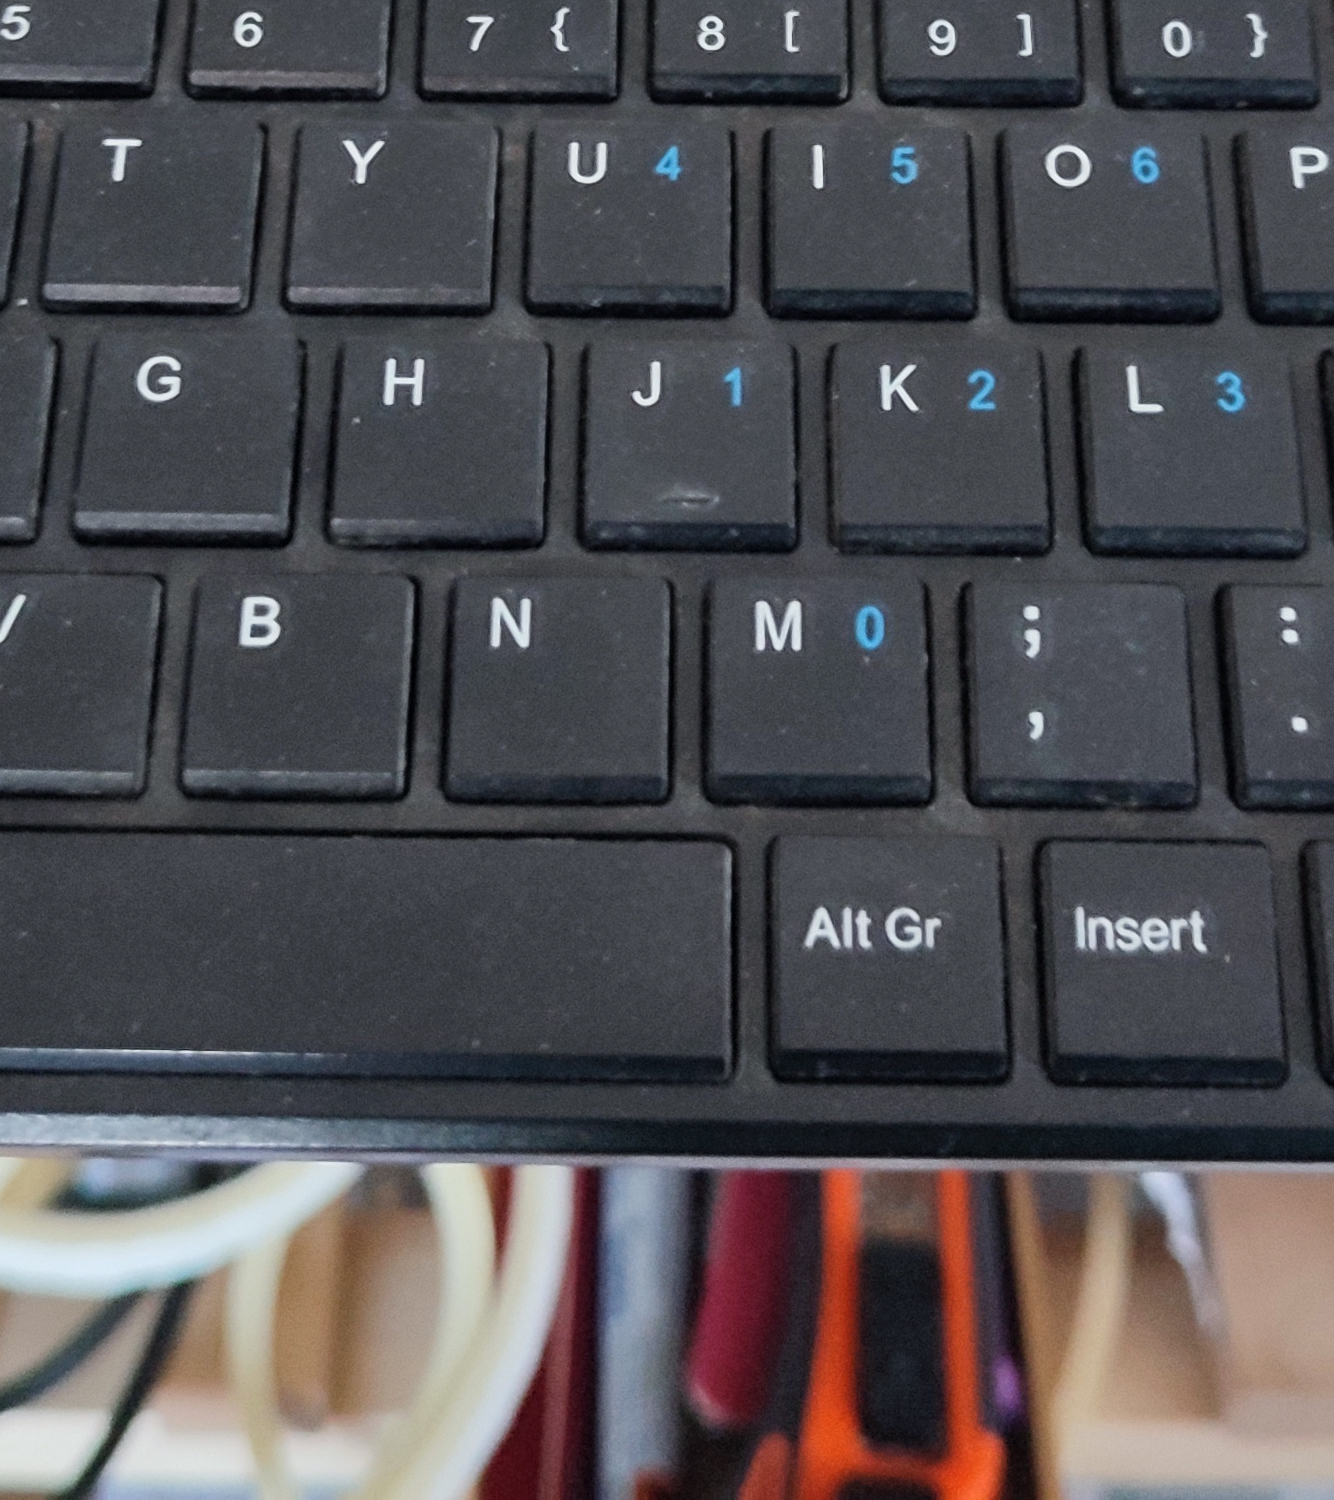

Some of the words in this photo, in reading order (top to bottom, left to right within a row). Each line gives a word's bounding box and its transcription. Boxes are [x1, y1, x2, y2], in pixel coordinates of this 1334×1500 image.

[232, 10, 264, 49] 6
[465, 14, 496, 53] 7
[696, 14, 727, 52] 8
[926, 17, 958, 58] 9
[1161, 19, 1194, 59] 0
[101, 136, 144, 183] T
[341, 138, 386, 186] Y
[567, 140, 609, 185] U
[653, 144, 683, 182] 4
[890, 144, 920, 186] 5
[1044, 142, 1093, 189] O
[1130, 144, 1161, 185] 6
[1288, 145, 1331, 190] P
[135, 354, 182, 404] G
[382, 356, 426, 408] H
[630, 359, 663, 408] J
[722, 365, 744, 408] 1
[878, 363, 920, 413] K
[966, 368, 997, 412] 2
[1125, 363, 1165, 415] L
[1215, 369, 1247, 414] 3
[238, 594, 282, 649] B
[489, 595, 533, 650] N
[753, 598, 803, 653] M
[854, 603, 886, 651] 0
[803, 905, 874, 951] Alt
[884, 905, 943, 952] Gr
[1073, 905, 1209, 955] Insert
